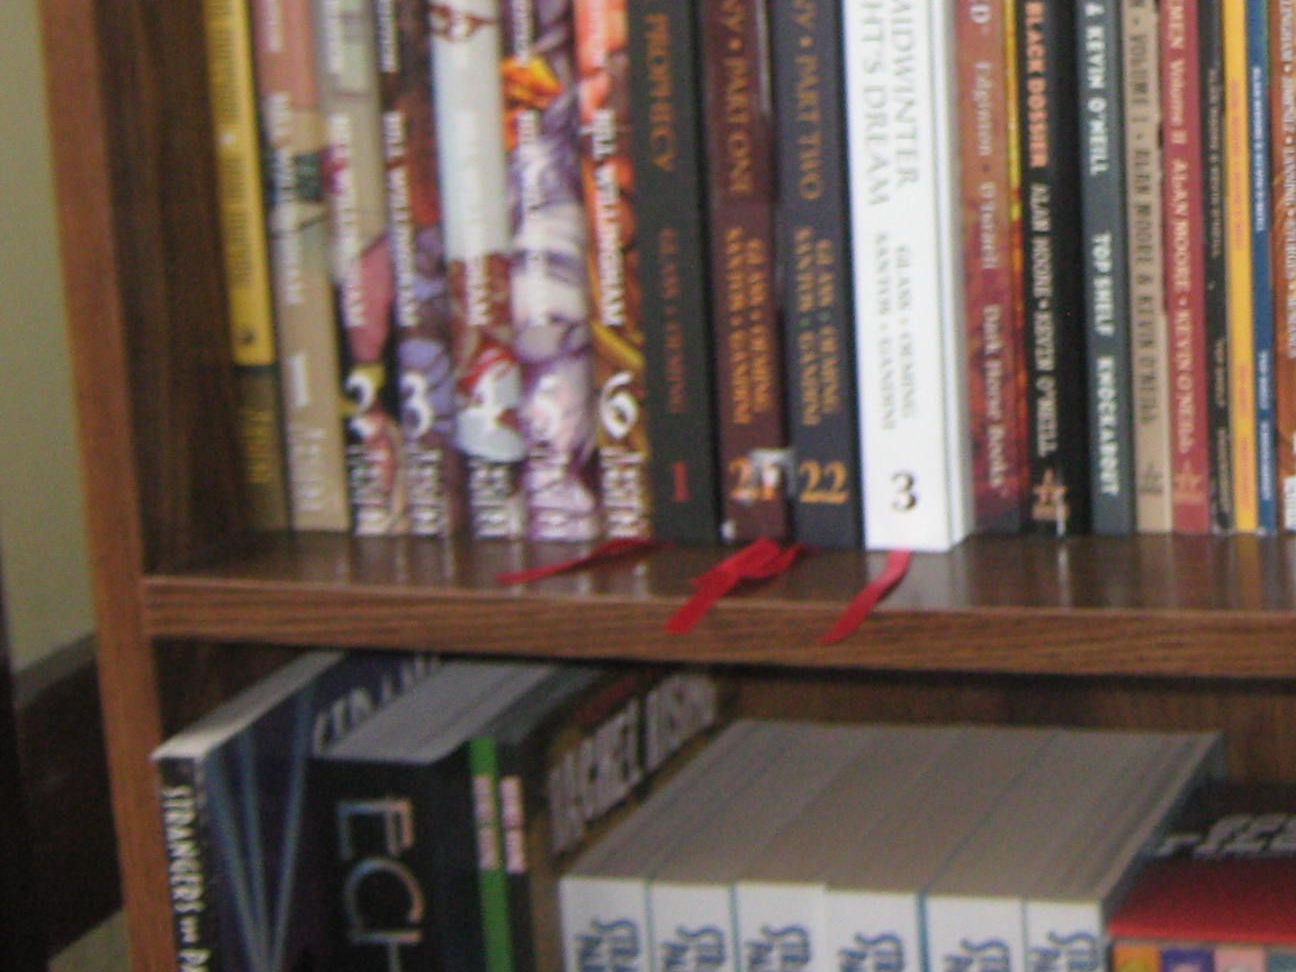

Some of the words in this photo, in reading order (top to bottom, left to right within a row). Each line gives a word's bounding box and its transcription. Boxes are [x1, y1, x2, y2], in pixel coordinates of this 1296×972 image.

[1025, 0, 1047, 74] BLACK
[1086, 25, 1107, 90] KEVIN
[862, 85, 891, 207] DREAM
[1028, 79, 1051, 169] DOSSIER
[1088, 96, 1111, 176] O'NEILL
[1092, 232, 1113, 273] TOP
[1094, 275, 1116, 336] SHELF
[400, 371, 434, 442] 3
[600, 370, 641, 440] 6
[1097, 354, 1120, 496] KNOCKABOUT
[891, 472, 921, 513] 3
[160, 785, 204, 914] STRANGERS
